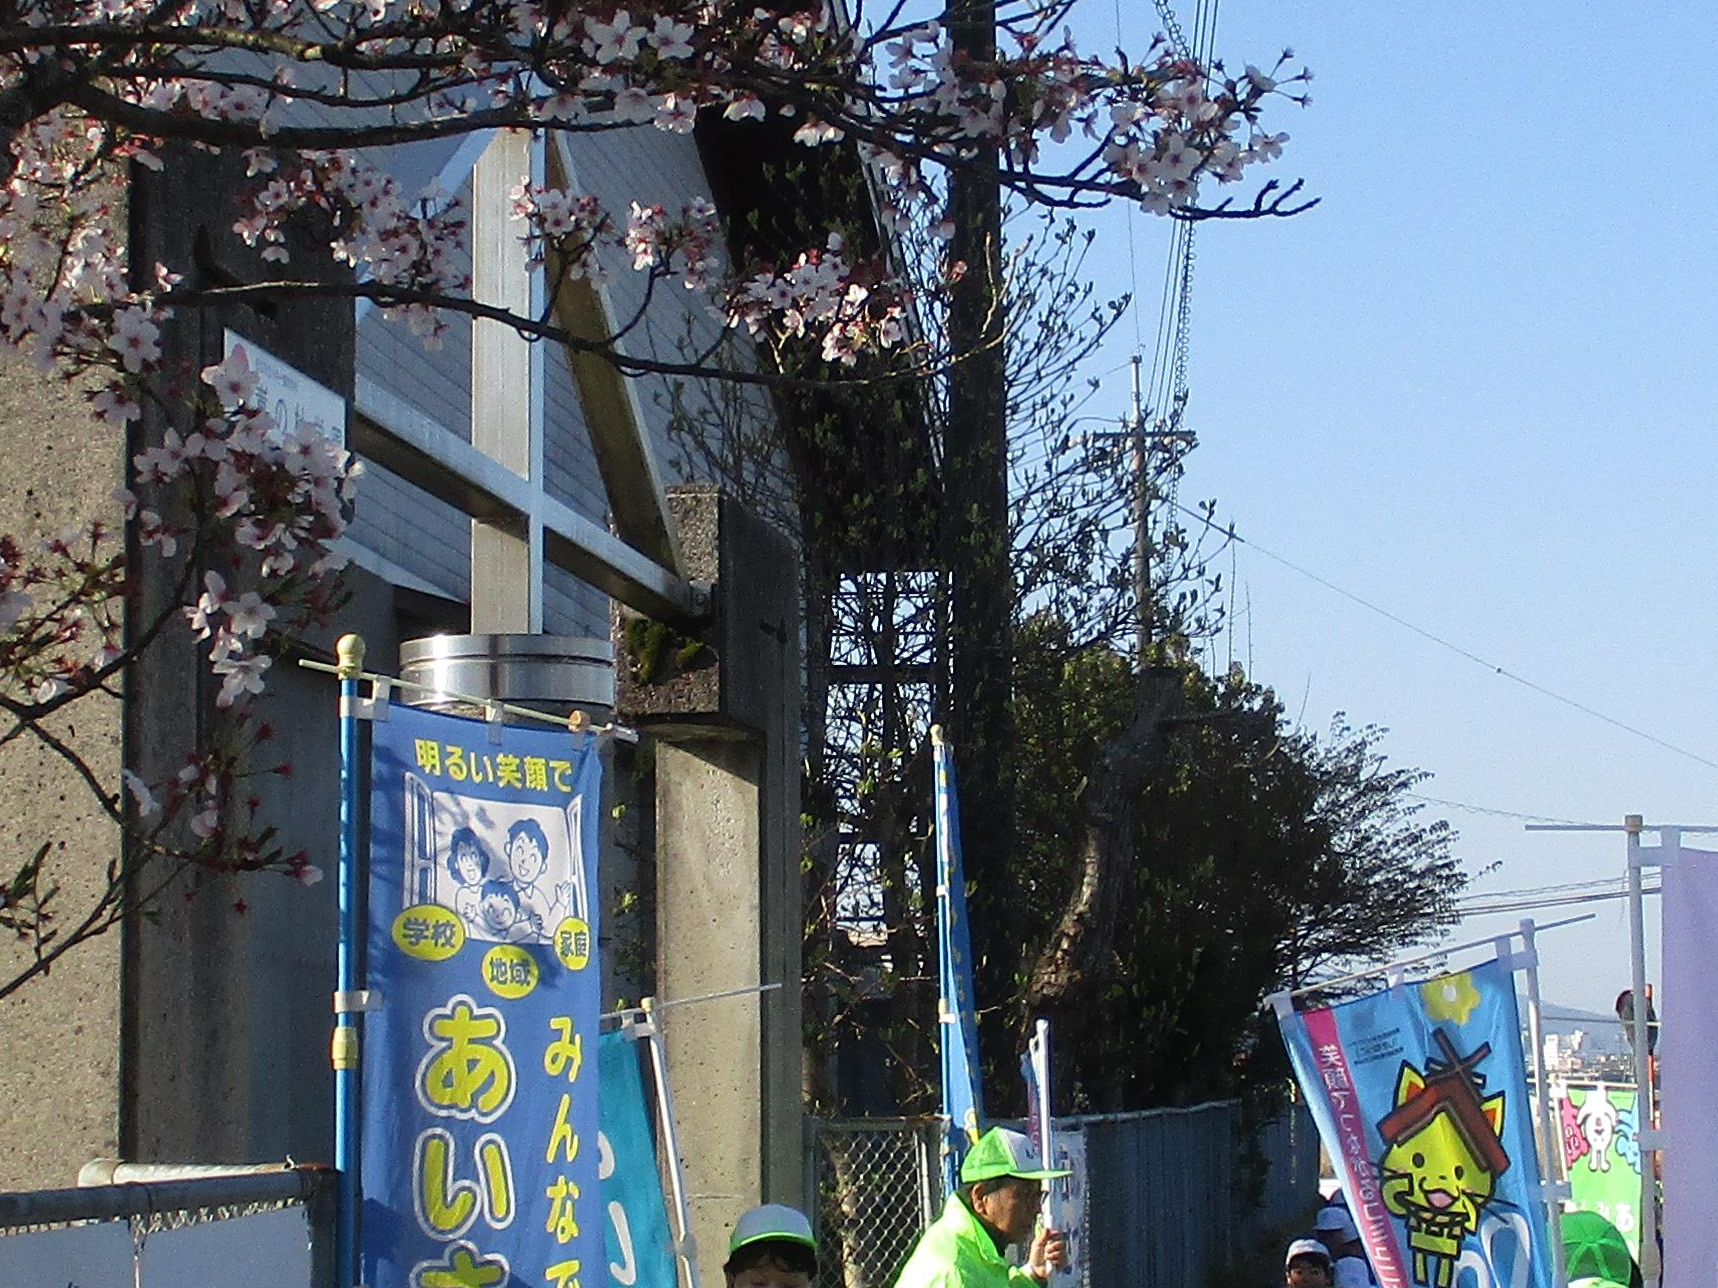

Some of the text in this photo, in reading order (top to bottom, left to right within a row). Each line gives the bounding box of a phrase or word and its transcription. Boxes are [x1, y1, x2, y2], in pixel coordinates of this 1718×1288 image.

[414, 738, 573, 793] 明るい笑顔で
[402, 917, 457, 949] 学校
[558, 930, 589, 959] 家庭
[489, 957, 533, 987] 地域
